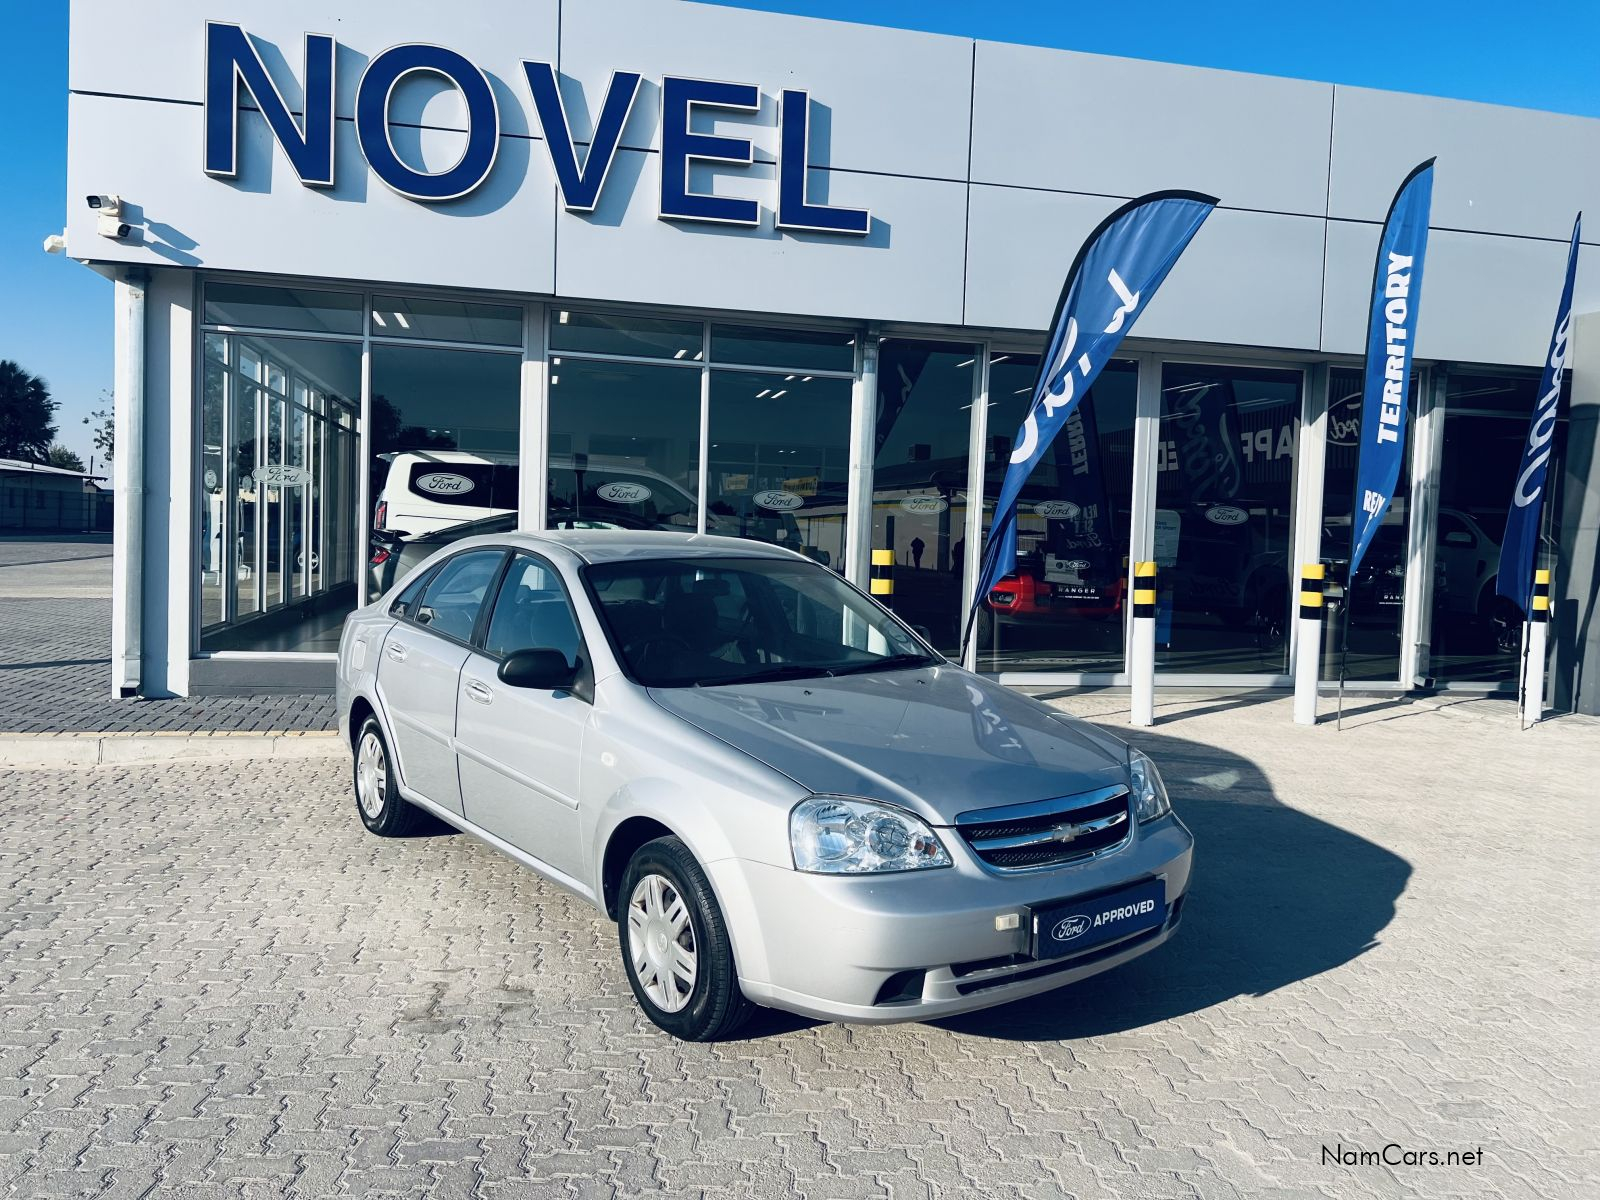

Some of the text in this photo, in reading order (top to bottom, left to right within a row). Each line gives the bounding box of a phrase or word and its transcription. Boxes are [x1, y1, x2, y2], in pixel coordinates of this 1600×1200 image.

[203, 19, 871, 236] NOVEL
[1377, 251, 1413, 444] TERRITORY
[267, 467, 301, 482] Ford
[428, 475, 462, 491] Ford
[608, 485, 640, 499] Ford
[763, 492, 793, 506] Ford
[910, 498, 938, 511] Ford
[1043, 503, 1070, 516] Ford
[1214, 509, 1240, 521] Ford
[1057, 899, 1155, 939] Ford APPROVED
